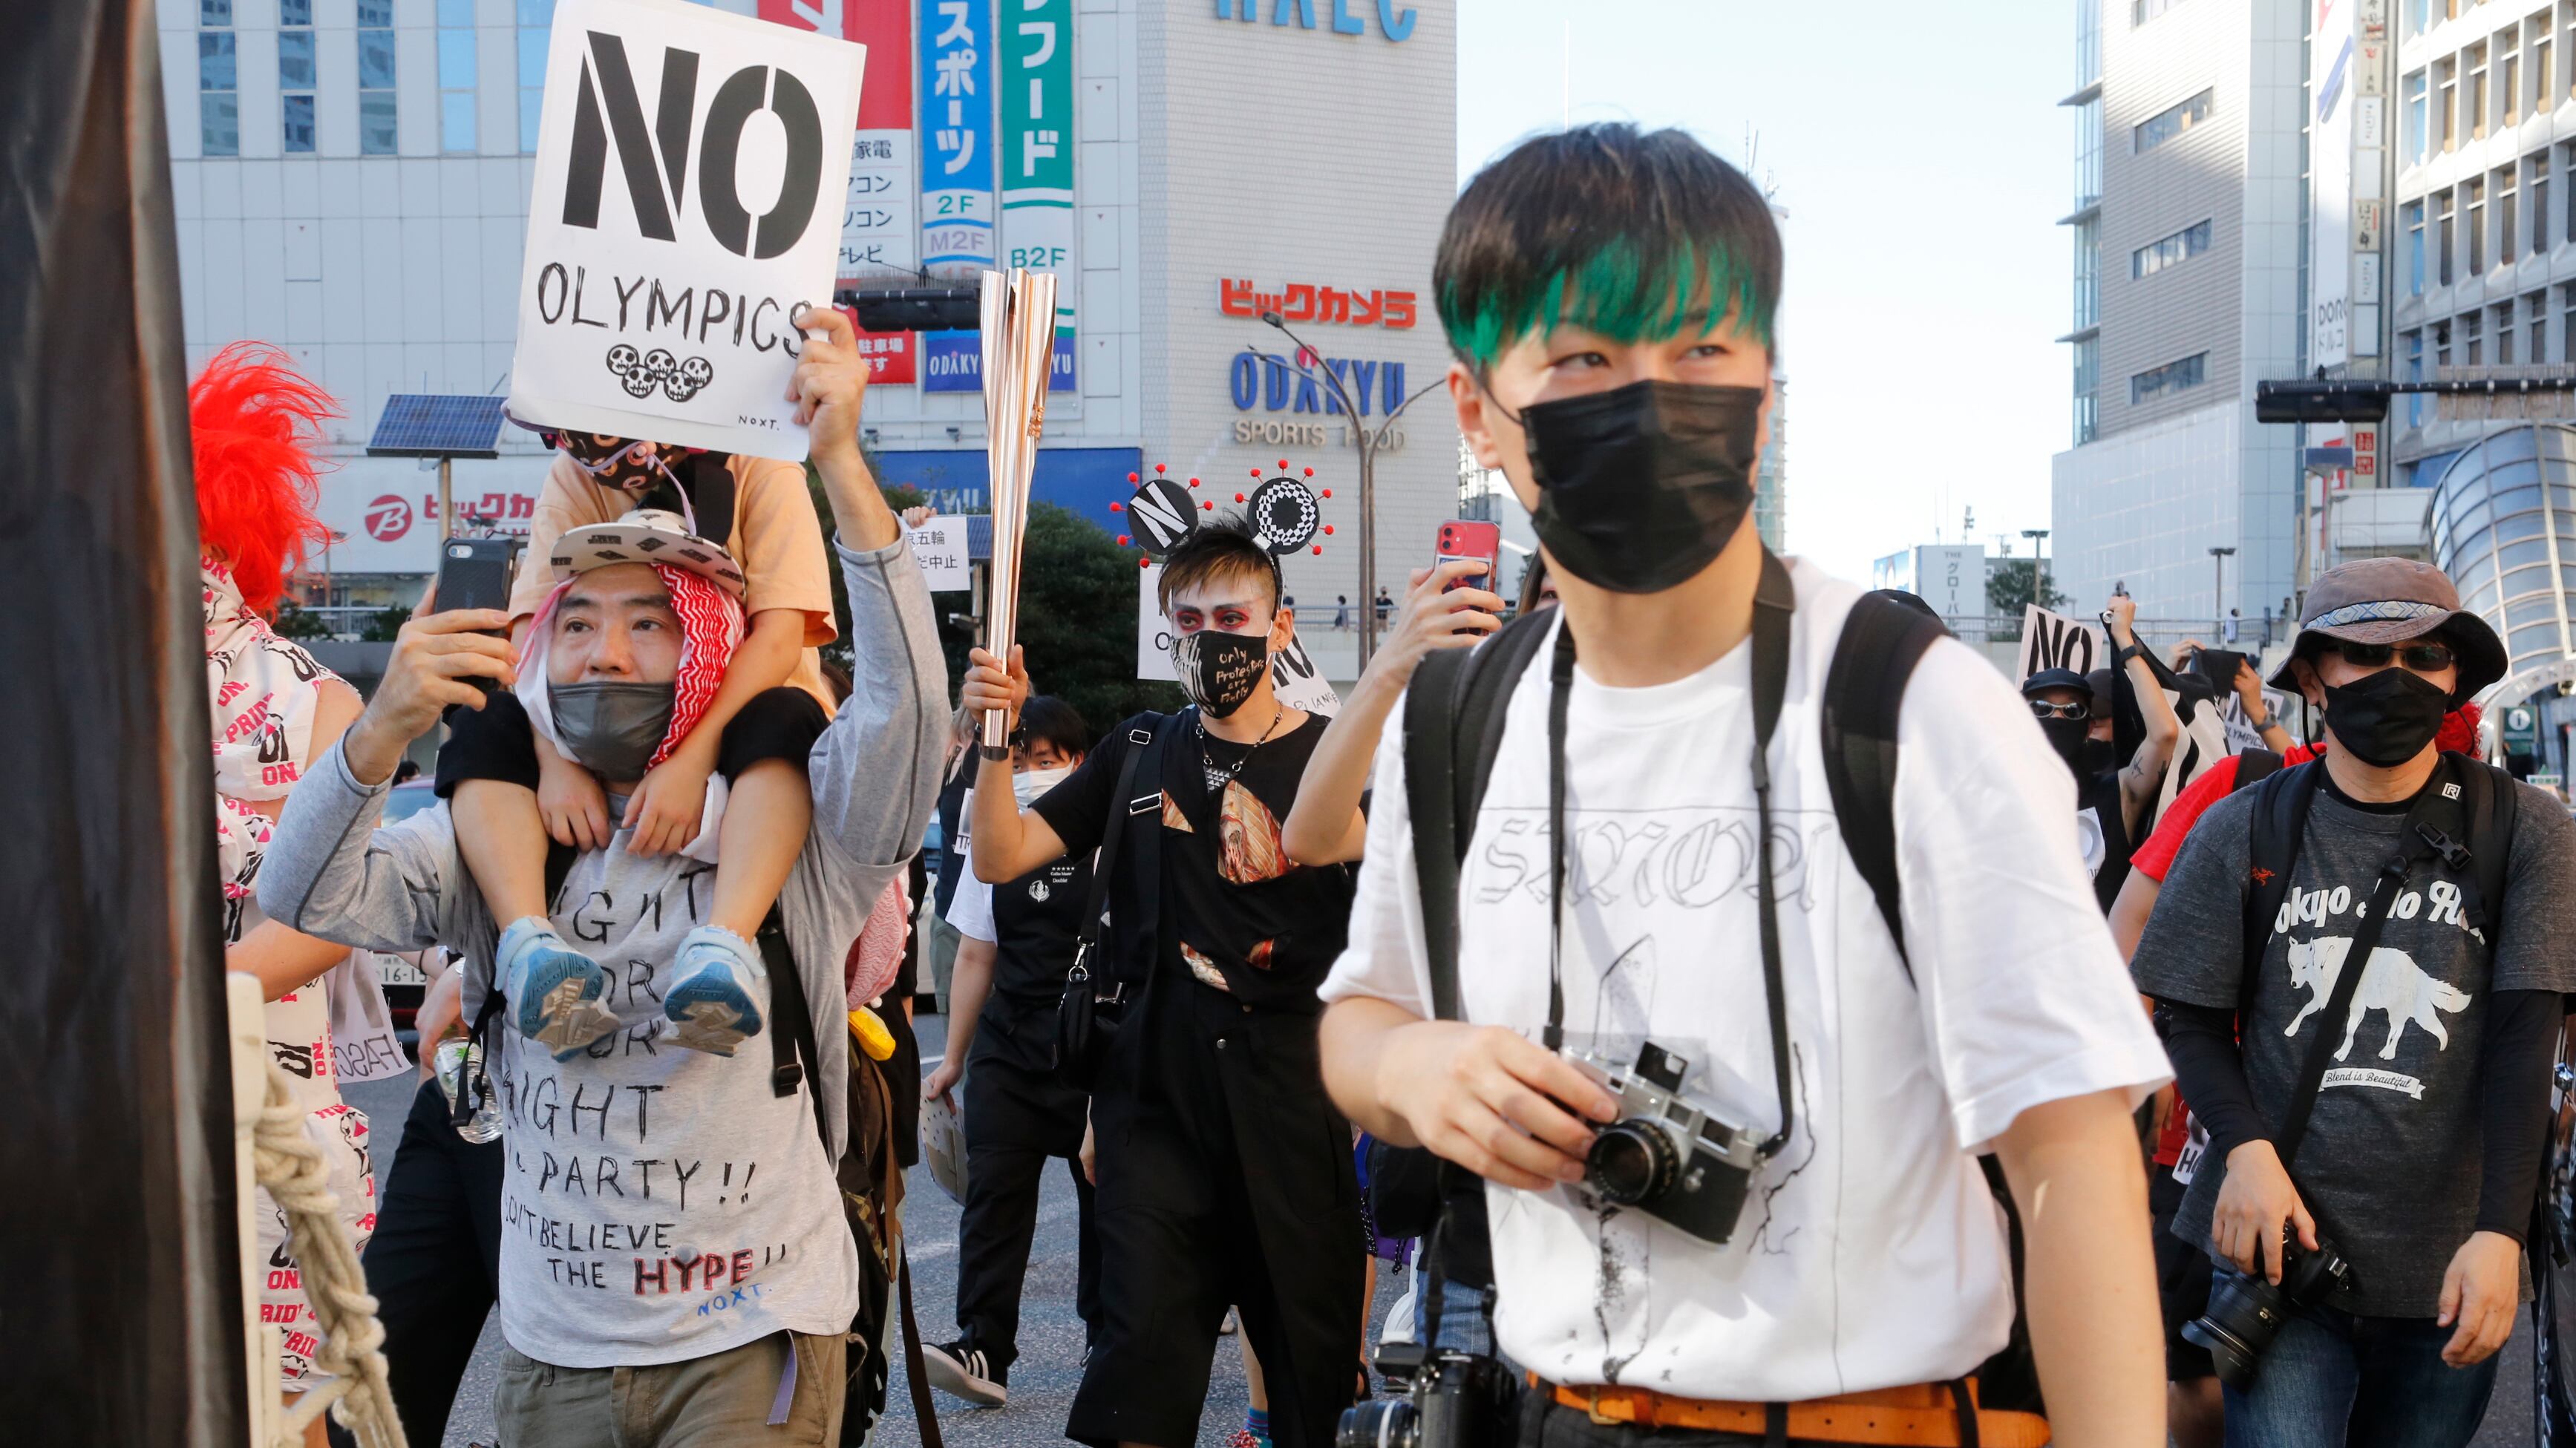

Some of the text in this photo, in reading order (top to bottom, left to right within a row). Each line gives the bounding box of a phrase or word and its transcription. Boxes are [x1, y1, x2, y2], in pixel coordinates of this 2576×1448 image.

[935, 1, 976, 174] スポーツ
[1019, 0, 1059, 177] フード
[562, 30, 823, 259] NO
[851, 140, 892, 160] 家電
[938, 195, 974, 214] 2F
[930, 231, 985, 252] M2F
[1011, 247, 1066, 267] B2F
[537, 262, 815, 358] OLYMPICS
[1220, 278, 1416, 328] ビックカメラ
[930, 351, 980, 376] ODAKY
[1230, 344, 1405, 416] ODAKYU
[1235, 420, 1405, 451] SPORTS FOOD
[1219, 646, 1246, 664] Only
[2027, 612, 2092, 678] NO
[2268, 885, 2352, 944] okyo
[2326, 1071, 2412, 1091] Blend is Beautiful
[546, 1257, 607, 1288] THE
